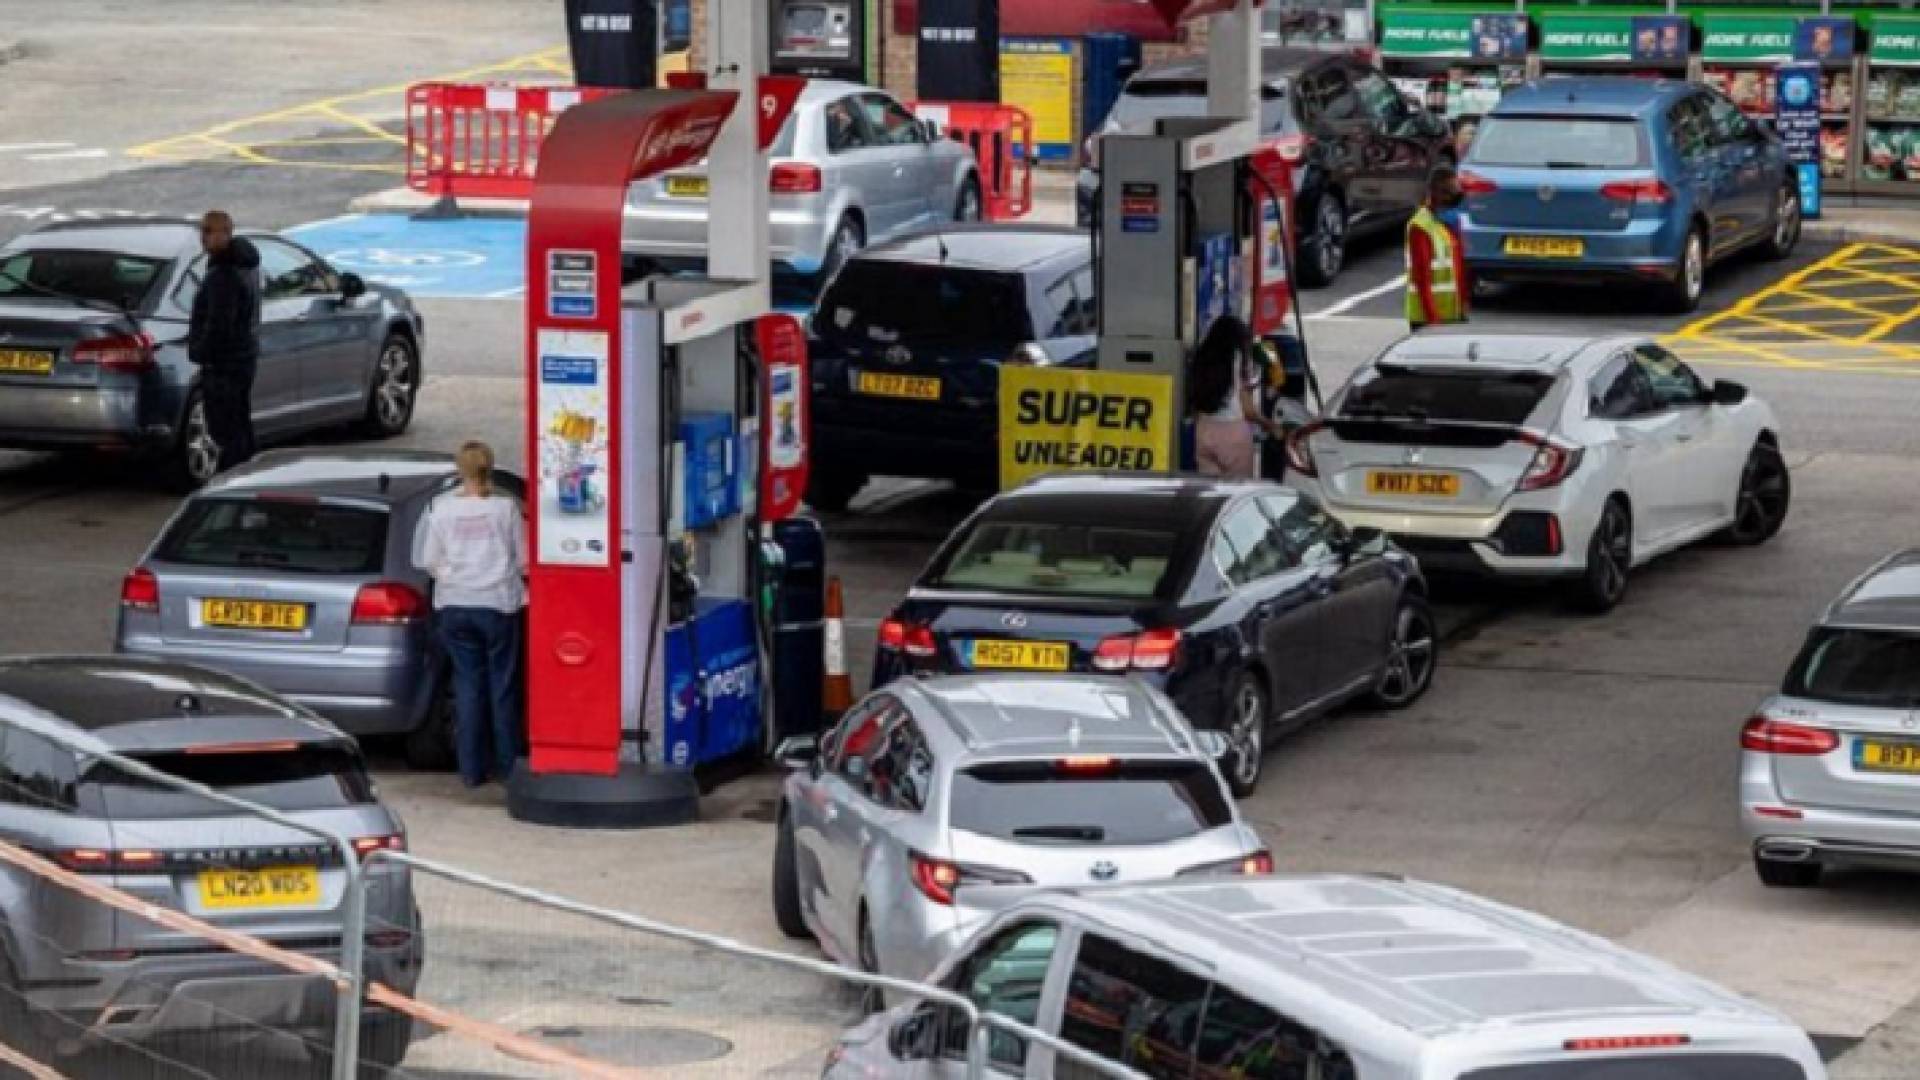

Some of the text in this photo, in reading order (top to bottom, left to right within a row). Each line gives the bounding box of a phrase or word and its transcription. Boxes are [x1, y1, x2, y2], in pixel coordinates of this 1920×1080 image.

[1384, 28, 1425, 41] HOME
[1705, 33, 1746, 46] HOME
[1876, 34, 1915, 47] HOME
[761, 95, 778, 119] 9
[1017, 389, 1153, 432] SUPER
[1015, 440, 1154, 470] UNLEADED
